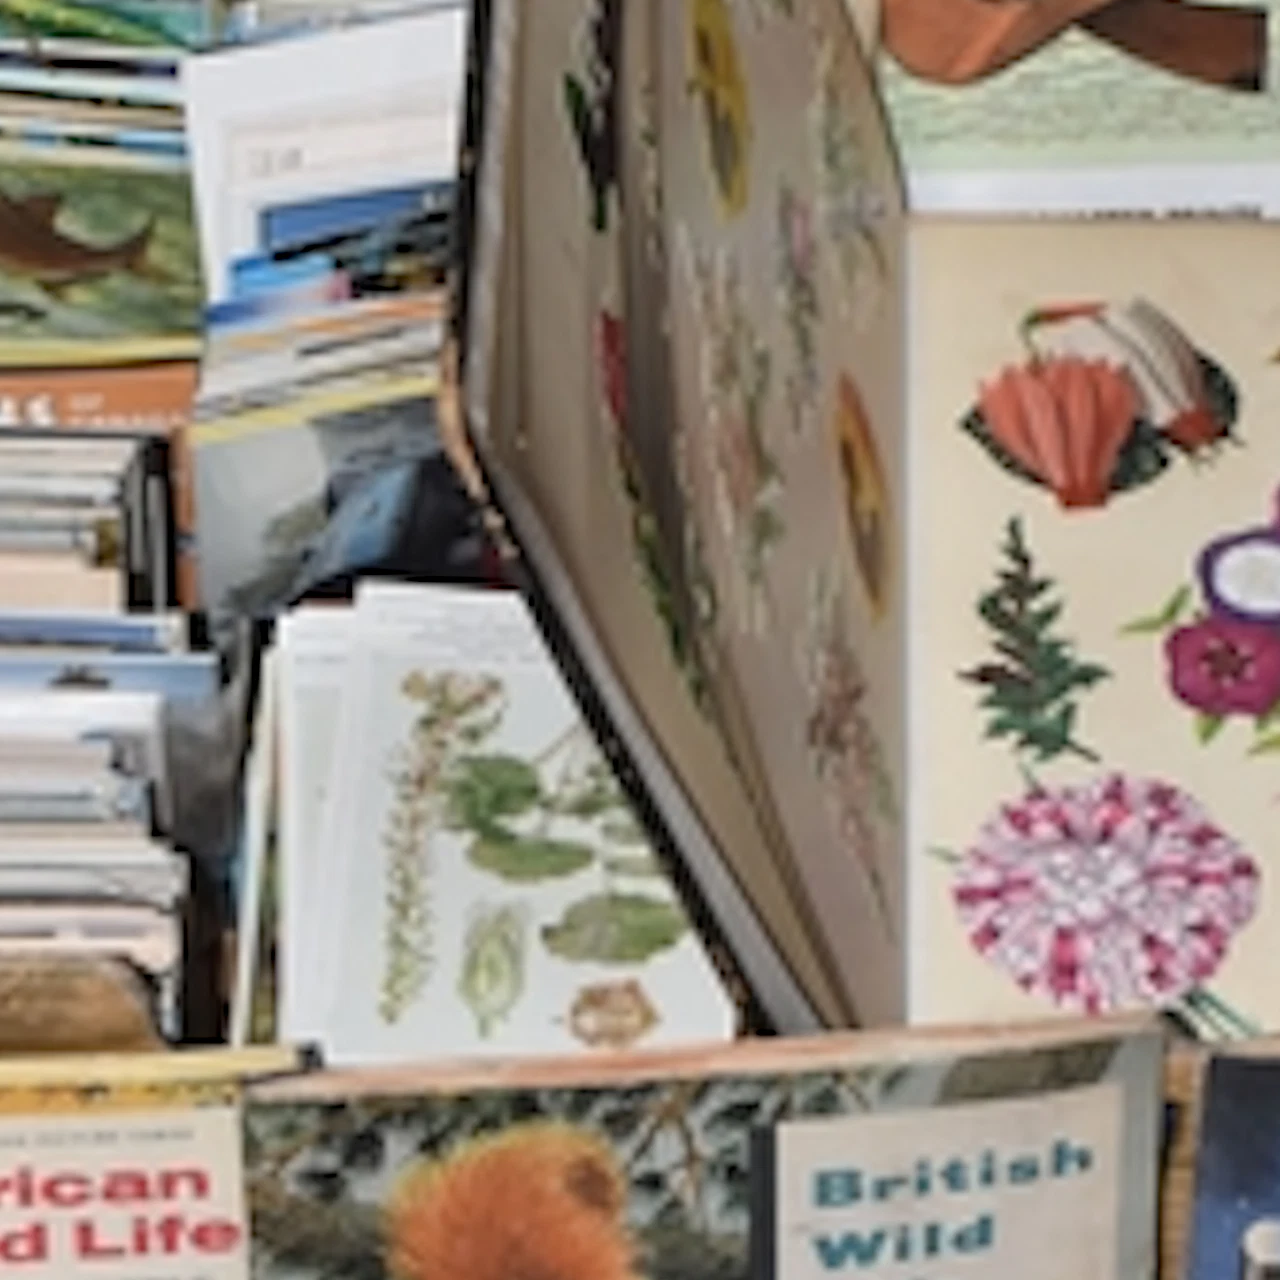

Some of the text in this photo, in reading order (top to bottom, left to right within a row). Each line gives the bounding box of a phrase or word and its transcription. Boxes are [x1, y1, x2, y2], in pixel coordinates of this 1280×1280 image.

[812, 1138, 1093, 1208] British
[74, 1214, 244, 1260] Life
[813, 1216, 995, 1271] Wild
